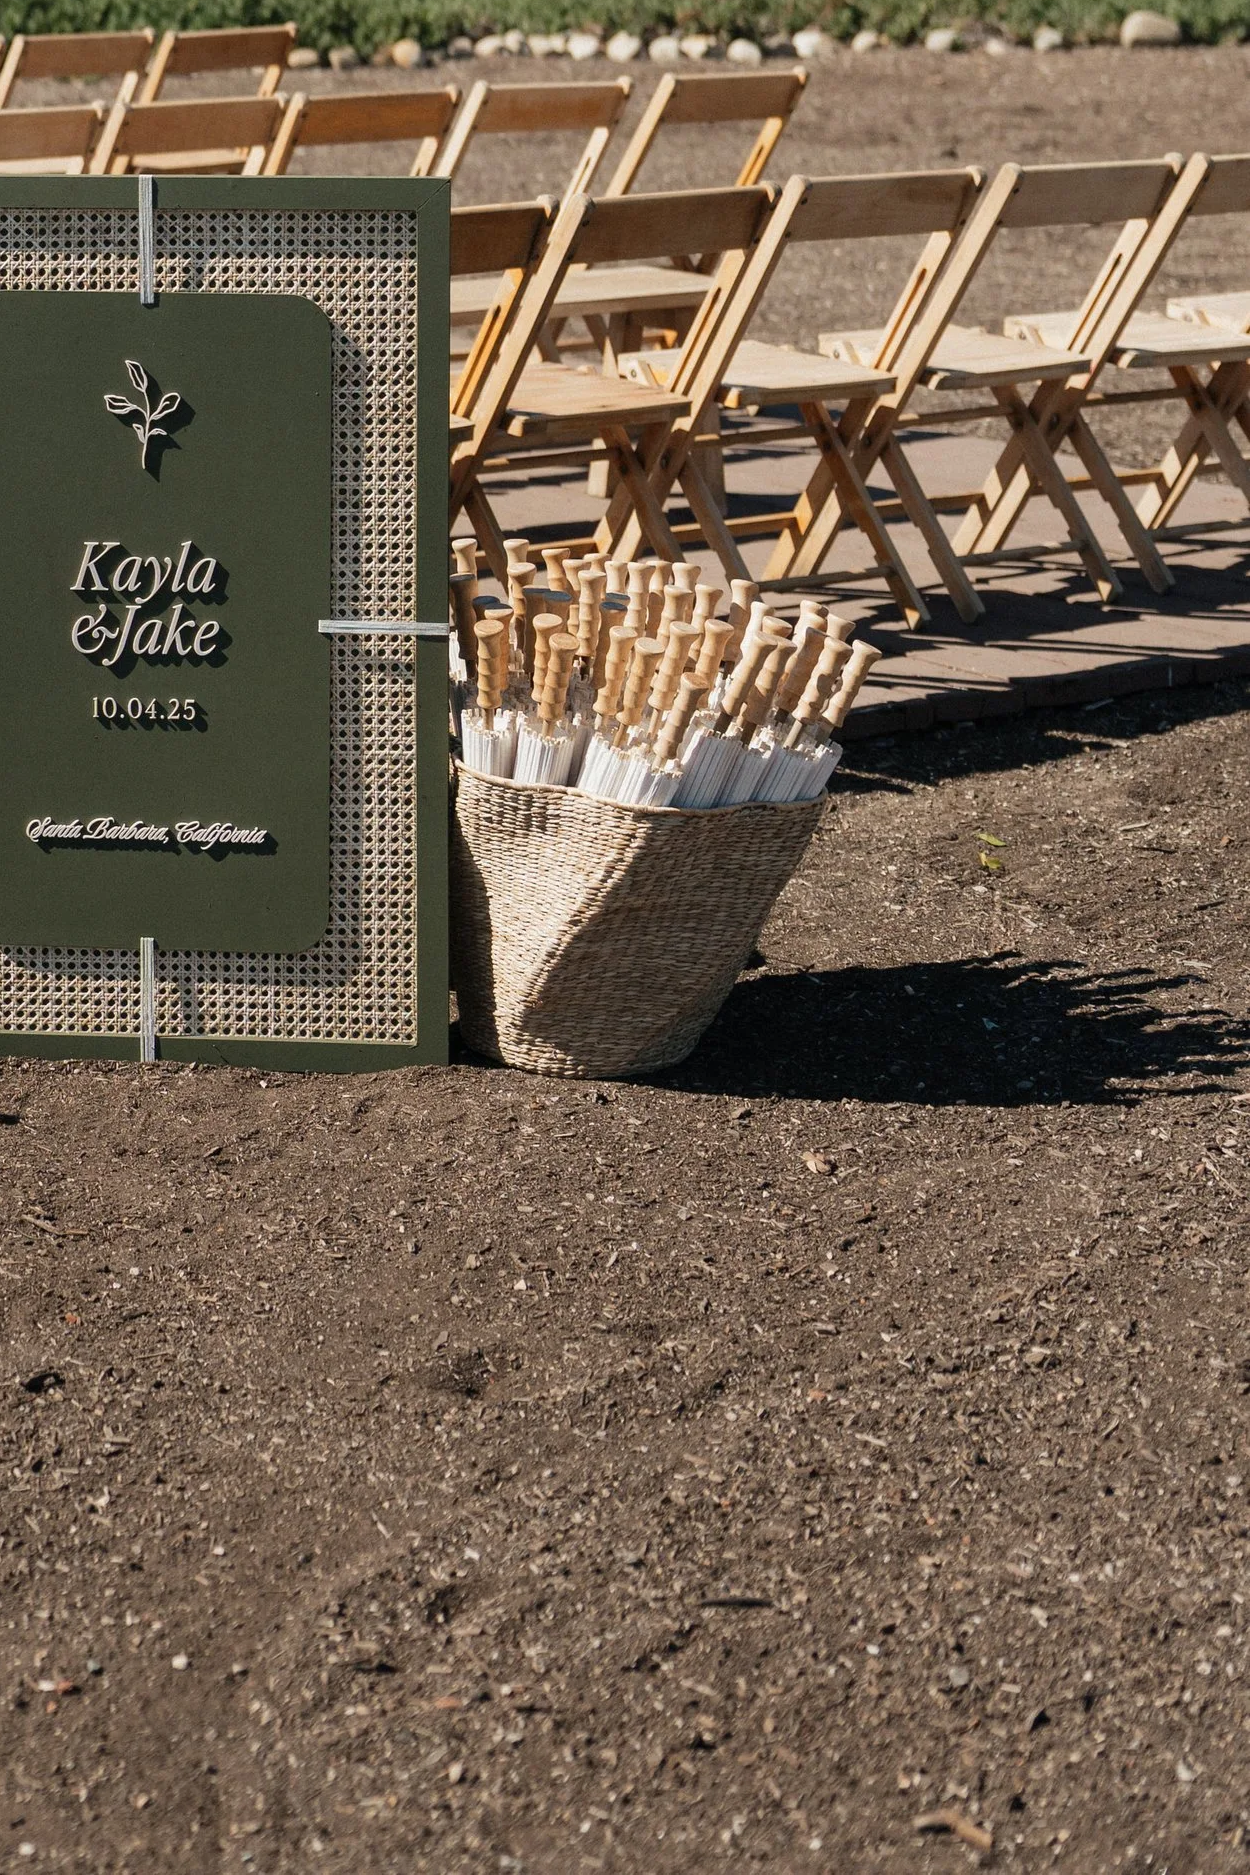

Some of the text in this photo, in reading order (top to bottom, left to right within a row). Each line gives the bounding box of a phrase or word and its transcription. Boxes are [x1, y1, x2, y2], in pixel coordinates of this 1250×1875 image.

[70, 540, 217, 604] Kayla
[92, 696, 196, 720] 10.04.25
[25, 816, 268, 850] Santa Barbara, California
